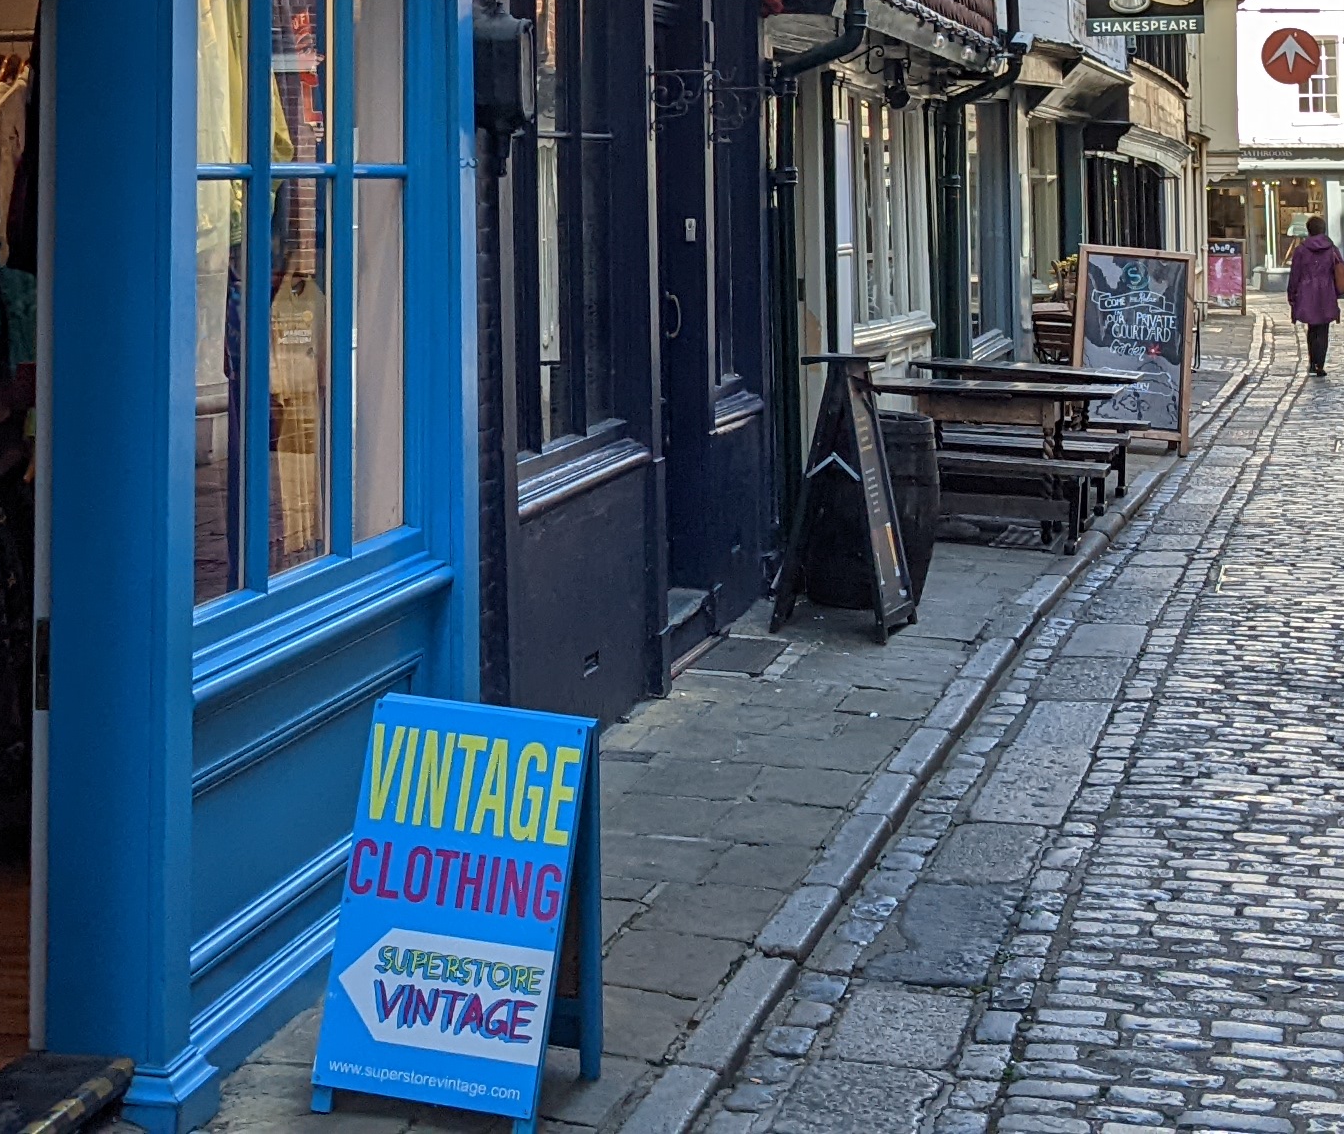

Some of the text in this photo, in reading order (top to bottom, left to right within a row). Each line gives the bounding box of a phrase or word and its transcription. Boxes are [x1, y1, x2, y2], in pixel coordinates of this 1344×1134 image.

[1092, 18, 1197, 33] SHAKESPEARE
[1112, 323, 1171, 342] COURTYARD
[1136, 312, 1177, 329] PRIVATE
[1110, 339, 1146, 361] Garden
[368, 722, 581, 847] VINTAGE
[349, 837, 562, 922] CLOTHING
[375, 945, 546, 996] SUPERSTORE
[373, 978, 538, 1044] VINTAGE
[329, 1058, 520, 1102] www.superstorevintage.com
